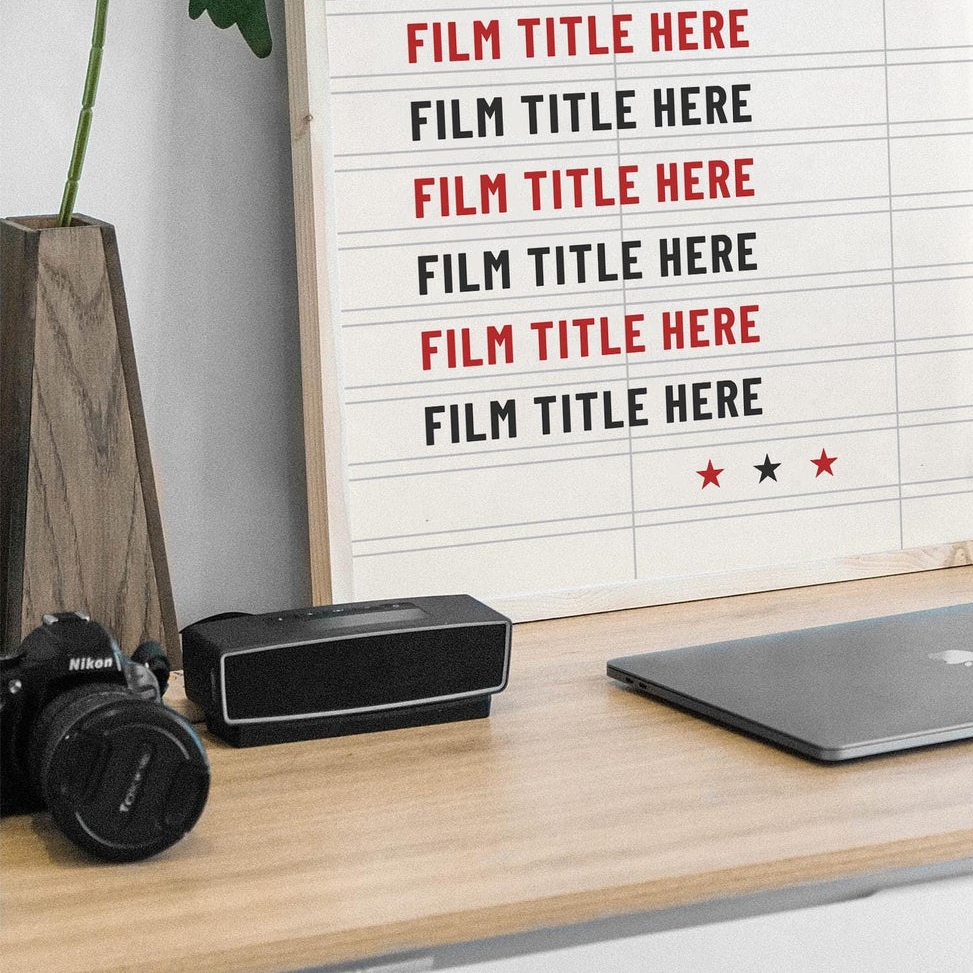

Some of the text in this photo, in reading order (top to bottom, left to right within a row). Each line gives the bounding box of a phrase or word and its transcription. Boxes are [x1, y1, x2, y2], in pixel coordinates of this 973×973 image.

[406, 8, 750, 64] FILM TITLE HERE
[410, 83, 752, 142] FILM TITLE HERE
[414, 157, 755, 219] FILM TITLE HERE
[417, 232, 758, 296] FILM TITLE HERE
[421, 304, 761, 371] FILM TITLE HERE
[424, 377, 763, 446] FILM TITLE HERE
[69, 657, 113, 671] Nikon
